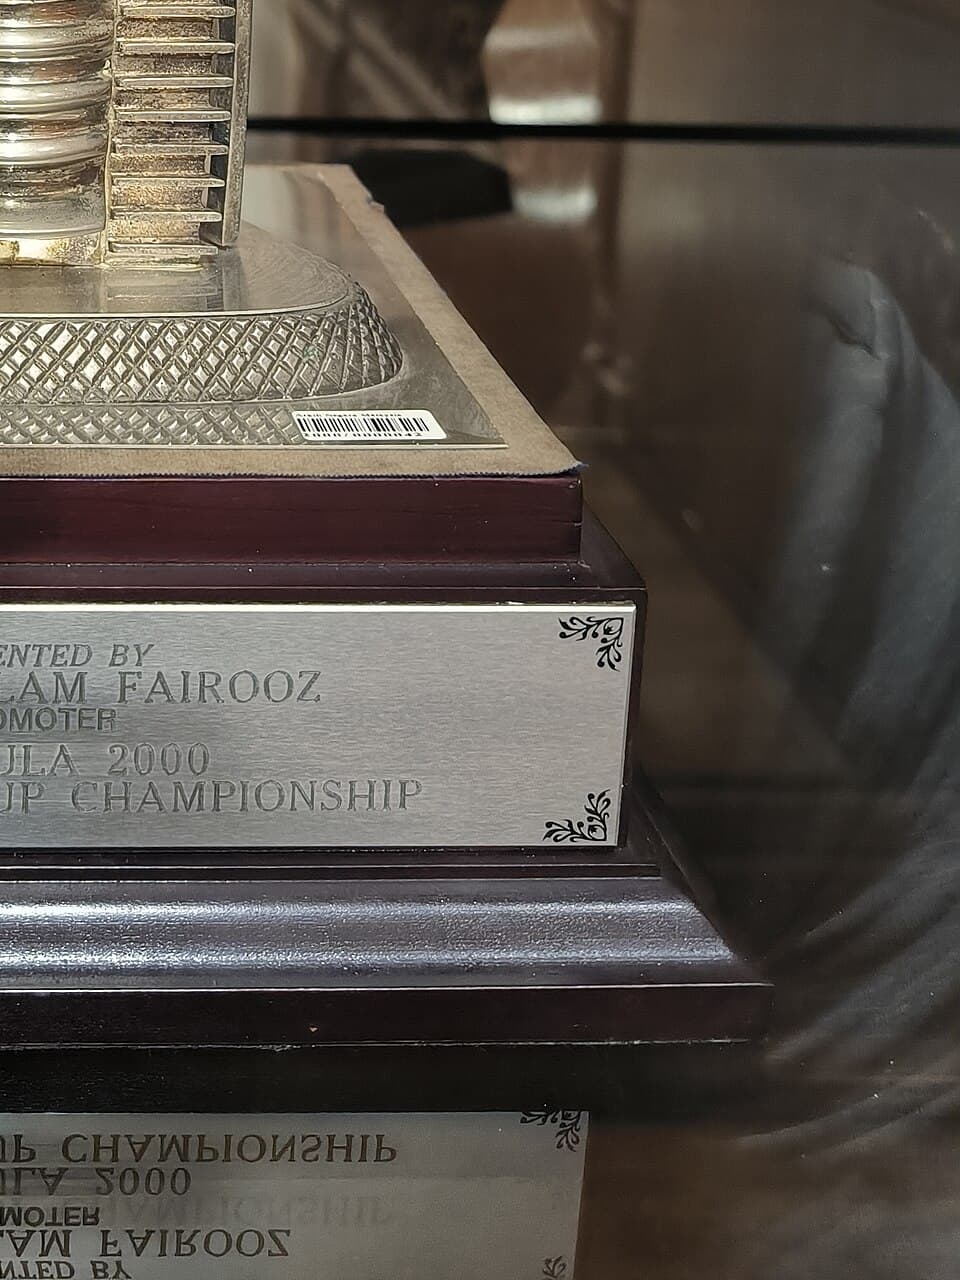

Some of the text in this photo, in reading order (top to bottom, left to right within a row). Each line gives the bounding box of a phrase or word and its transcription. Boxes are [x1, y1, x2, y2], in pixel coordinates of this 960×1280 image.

[109, 644, 154, 668] BY
[118, 669, 321, 704] FAIROOZ
[108, 742, 210, 776] 2000
[71, 779, 423, 812] CHAMPIONSHIP
